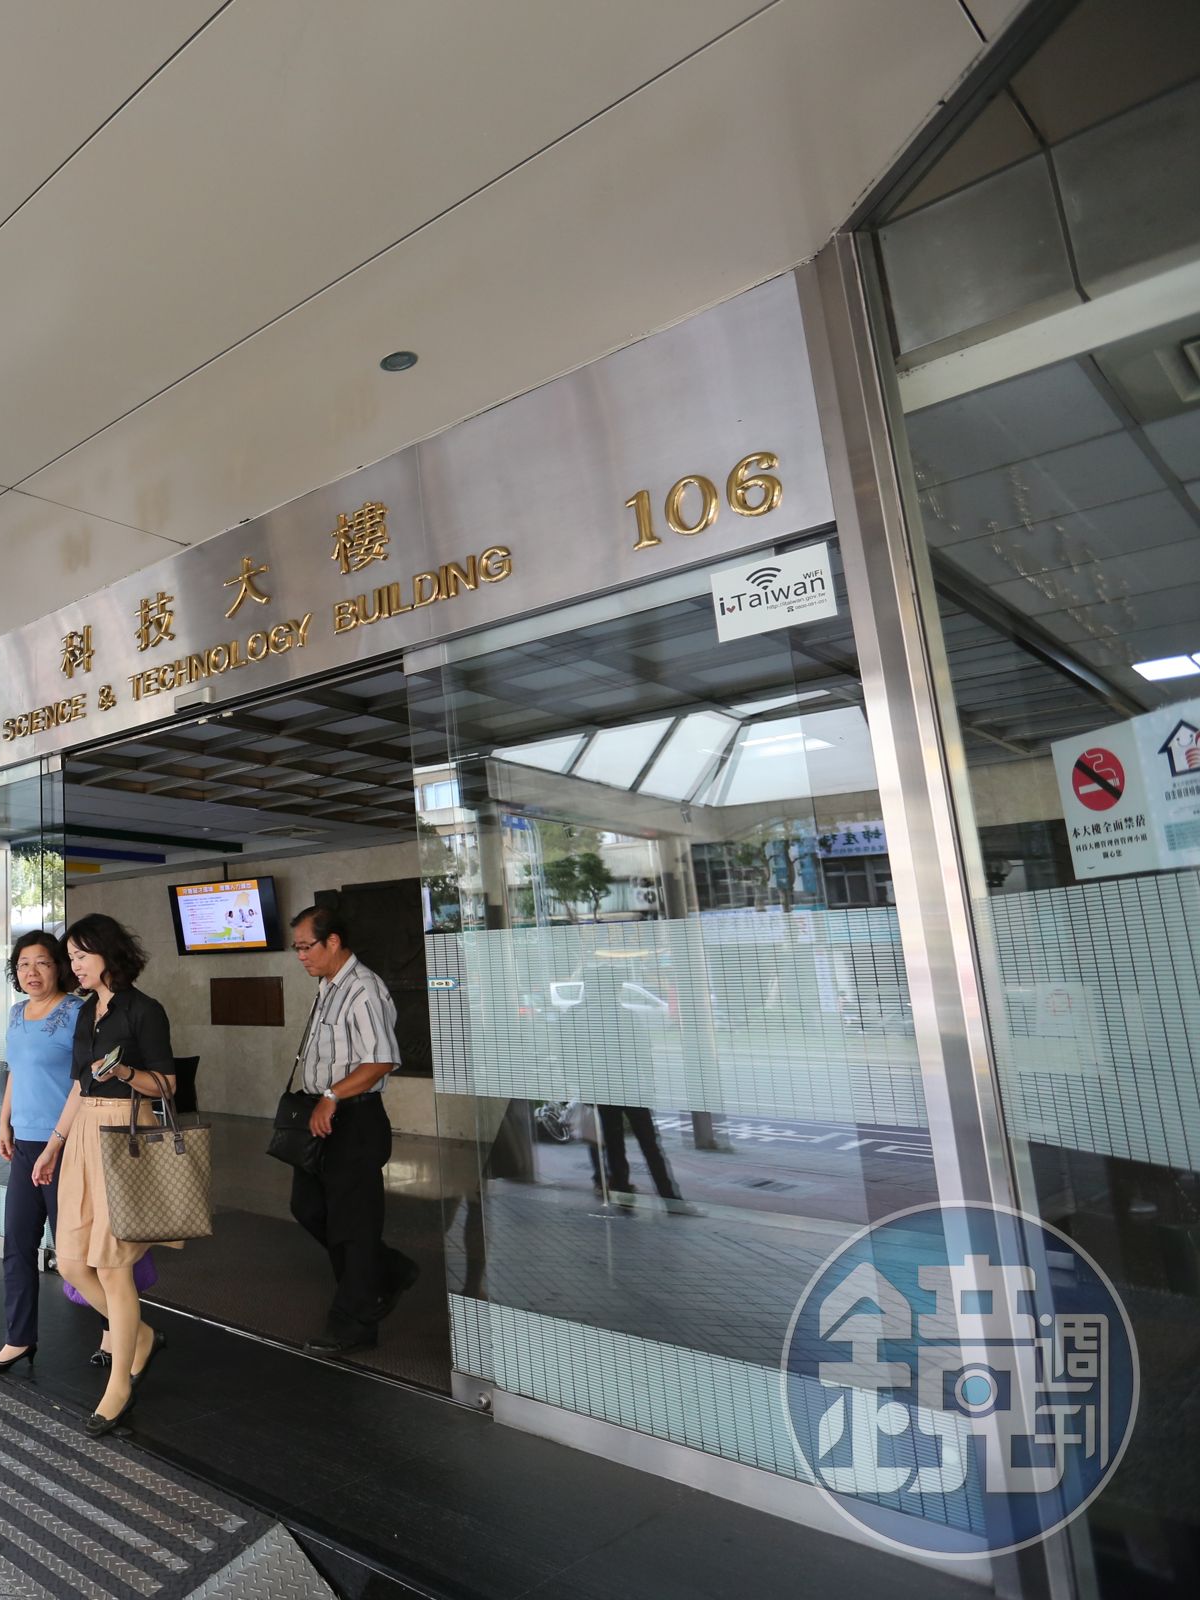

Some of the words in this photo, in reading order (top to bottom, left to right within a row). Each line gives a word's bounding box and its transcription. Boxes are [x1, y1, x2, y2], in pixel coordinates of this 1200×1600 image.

[625, 451, 783, 551] 106
[2, 692, 88, 742] SCIENCE
[98, 684, 118, 712] &
[127, 612, 314, 702] TECHNOLOGY
[333, 545, 513, 636] BUILDING
[59, 500, 392, 680] 科技大樓
[802, 568, 823, 580] WiFi
